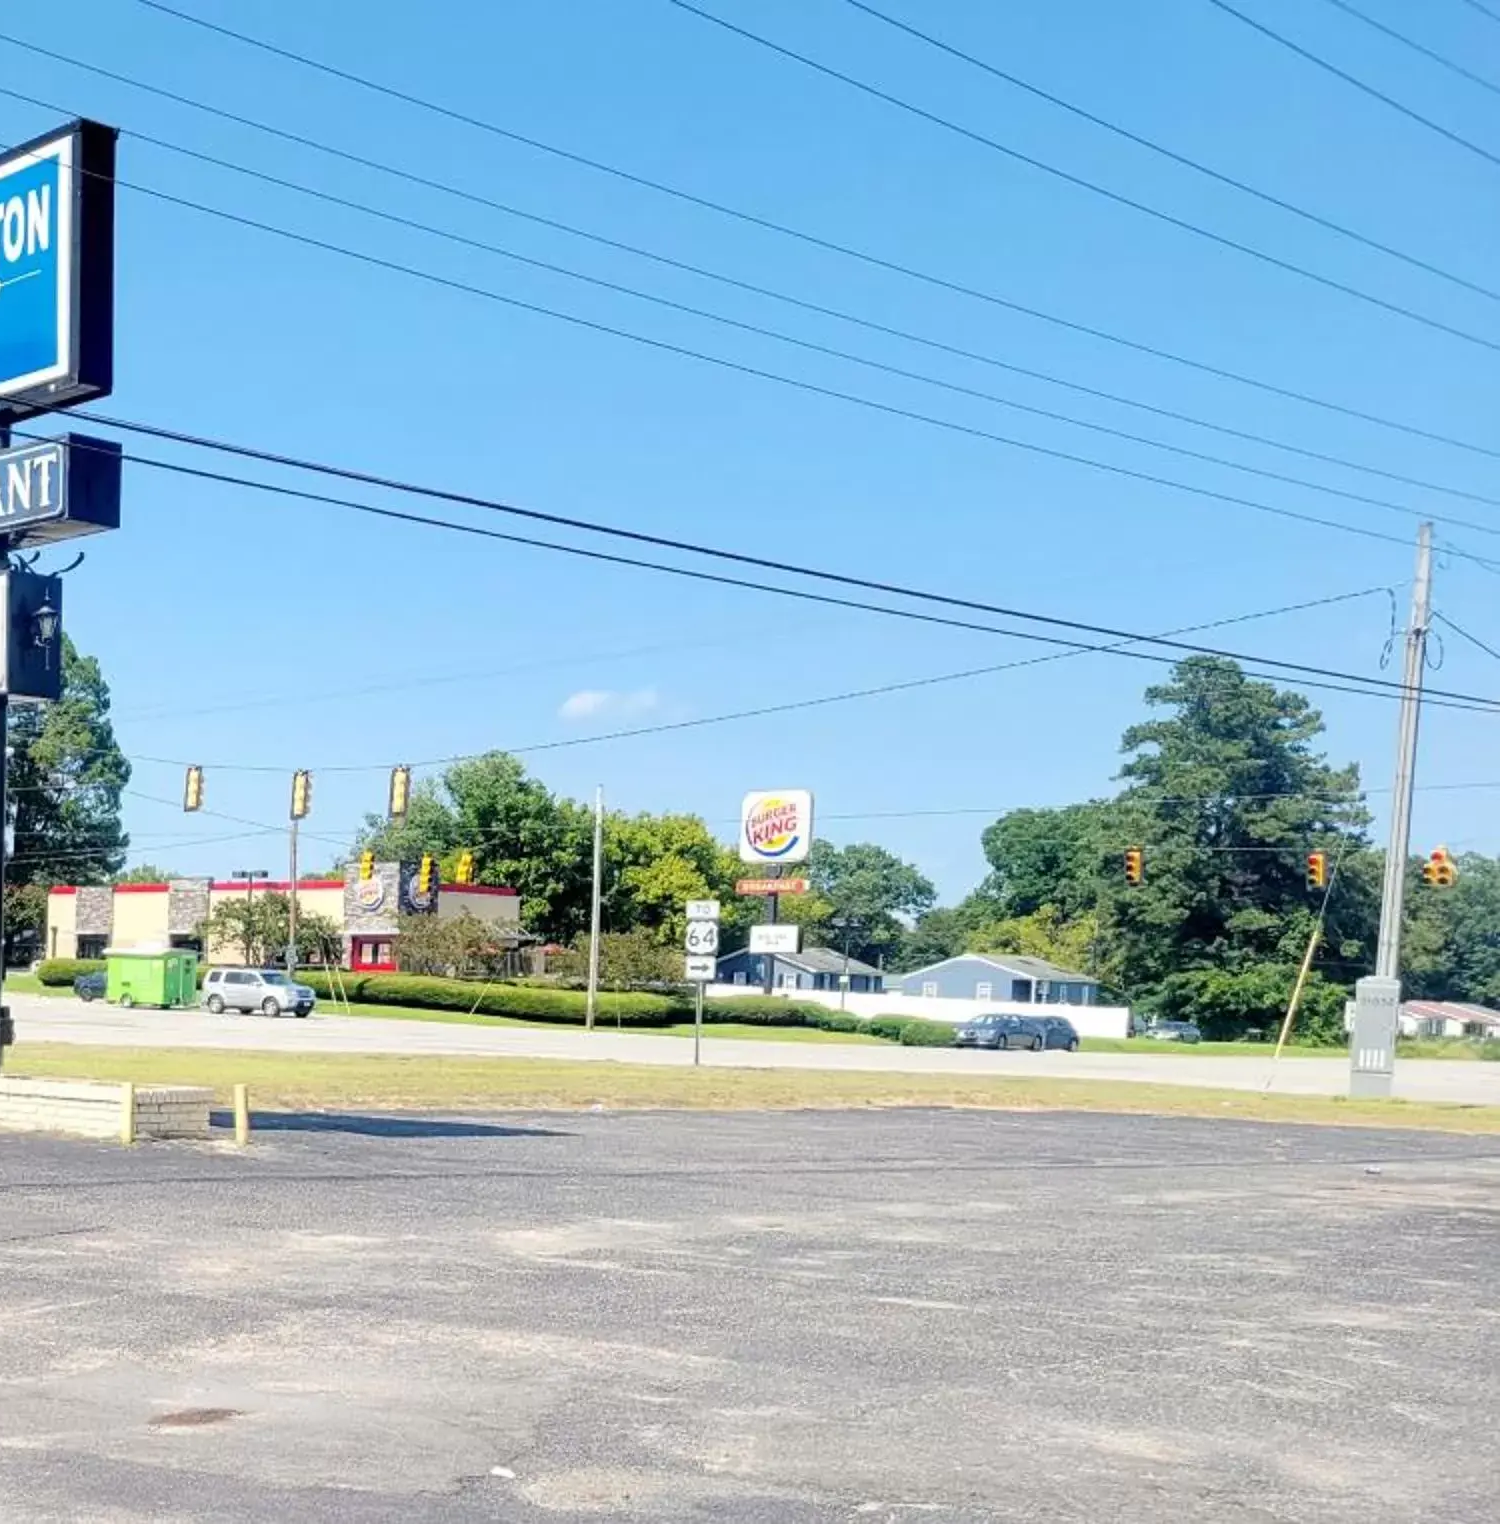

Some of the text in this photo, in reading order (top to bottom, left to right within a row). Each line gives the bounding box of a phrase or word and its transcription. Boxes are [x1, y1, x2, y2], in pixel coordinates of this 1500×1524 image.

[751, 803, 797, 828] BURGER
[752, 816, 798, 845] KING
[687, 927, 716, 947] 64
